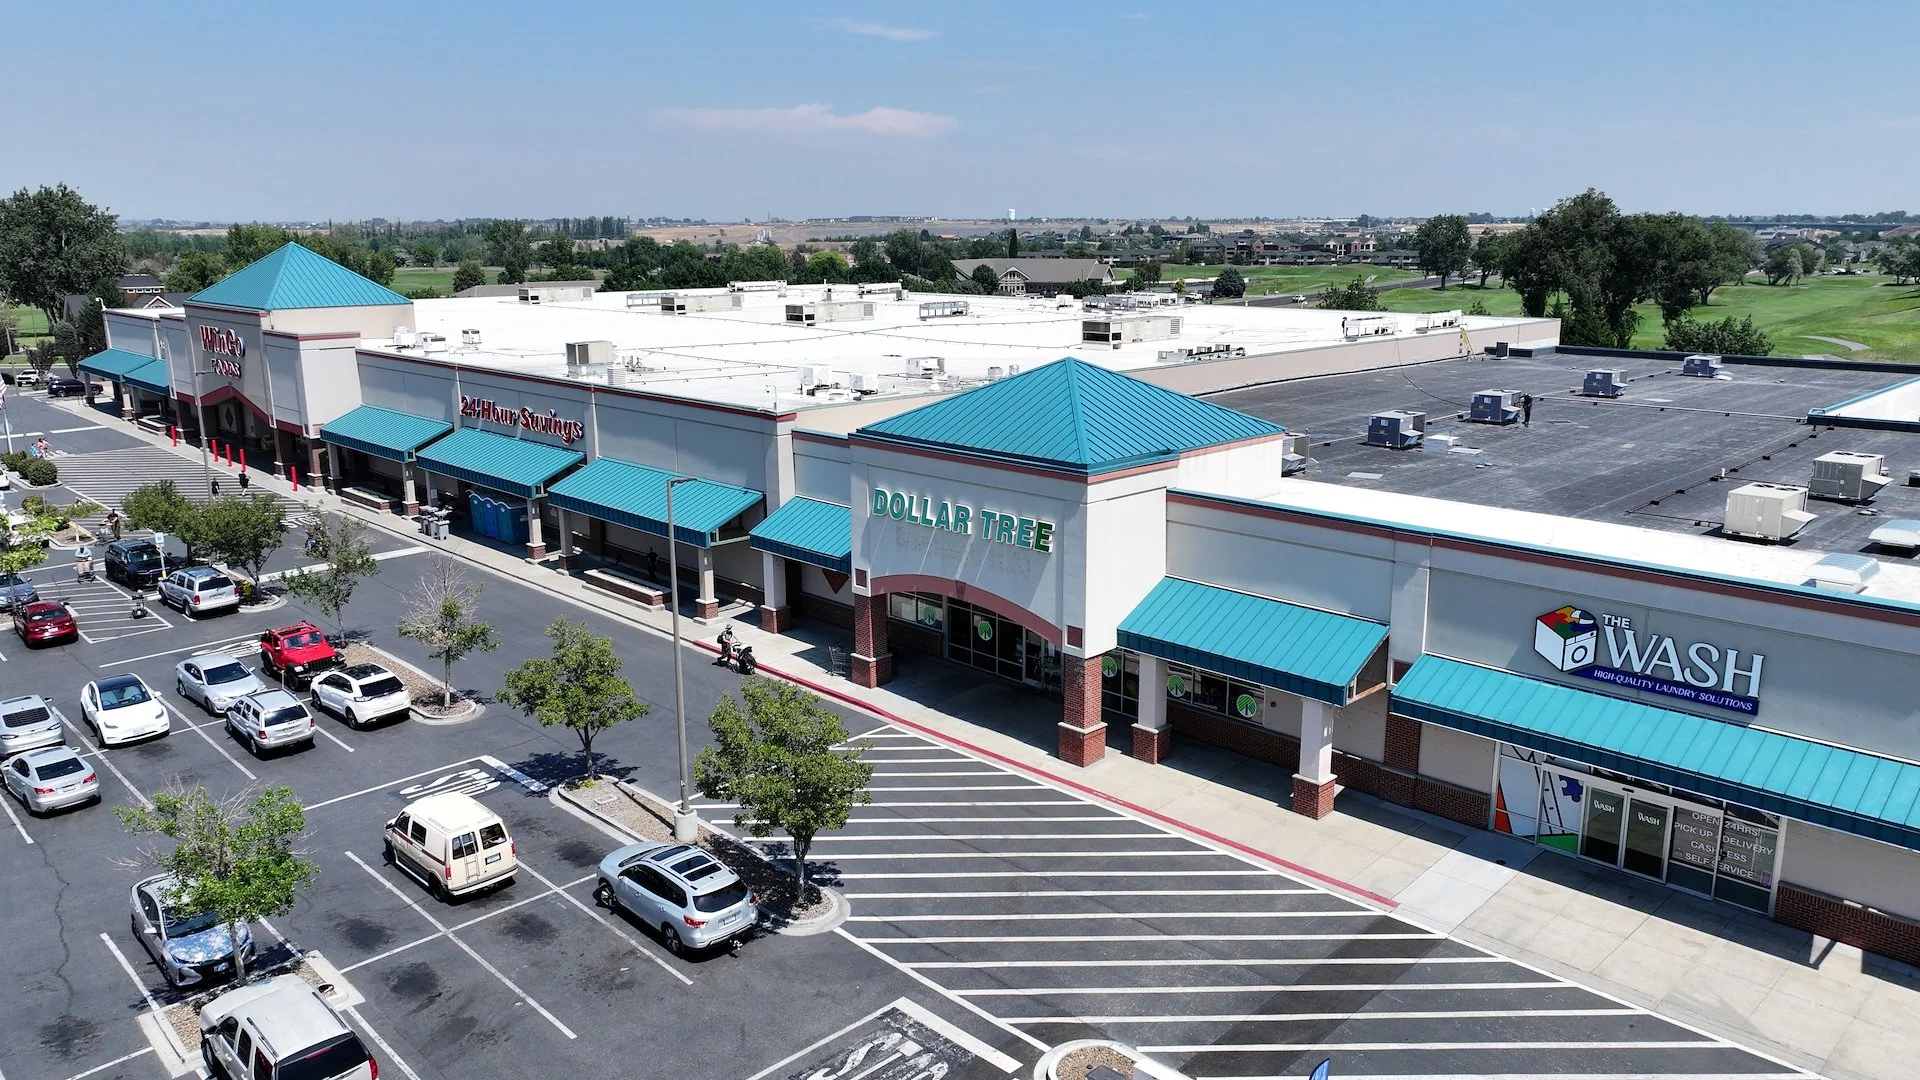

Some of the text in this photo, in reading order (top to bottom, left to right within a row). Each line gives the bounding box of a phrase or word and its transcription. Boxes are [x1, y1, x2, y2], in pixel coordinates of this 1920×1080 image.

[480, 399, 519, 427] Hour
[520, 406, 584, 445] Savings
[872, 487, 1055, 554] DOLLAR TREE
[1602, 614, 1631, 629] THE
[1603, 625, 1765, 699] WASH
[1594, 669, 1752, 711] HIGH-QUALITY LAUNDRY SOLUTIONS
[1692, 812, 1720, 826] OPEN
[1673, 821, 1774, 856] PICK UP DELIVERY
[1684, 852, 1710, 865] SELF
